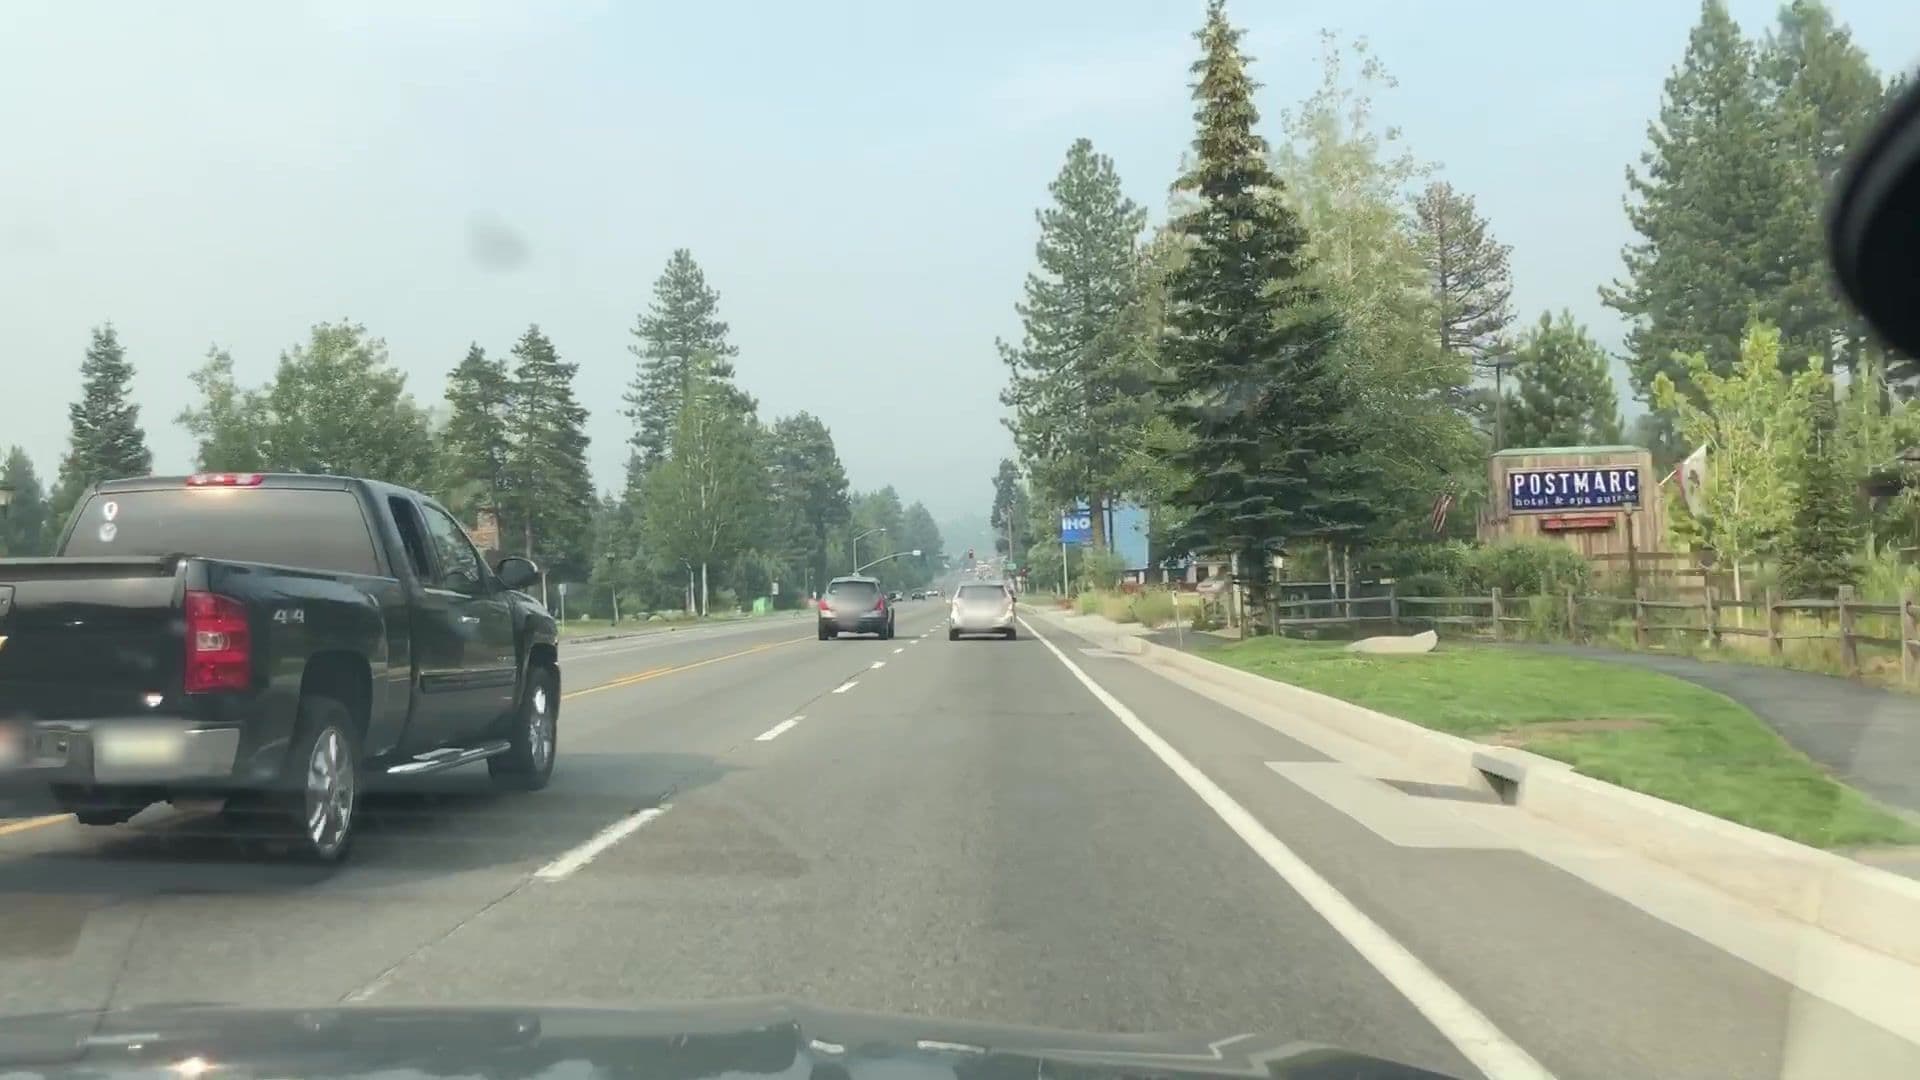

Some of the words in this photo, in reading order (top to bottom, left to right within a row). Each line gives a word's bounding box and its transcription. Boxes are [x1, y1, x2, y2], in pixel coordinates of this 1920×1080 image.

[1514, 471, 1636, 495] POSTMARC
[1515, 496, 1549, 506] hotel
[1555, 496, 1564, 505] &
[1569, 496, 1591, 506] spa
[1062, 517, 1091, 530] IHO
[272, 608, 305, 624] 44
